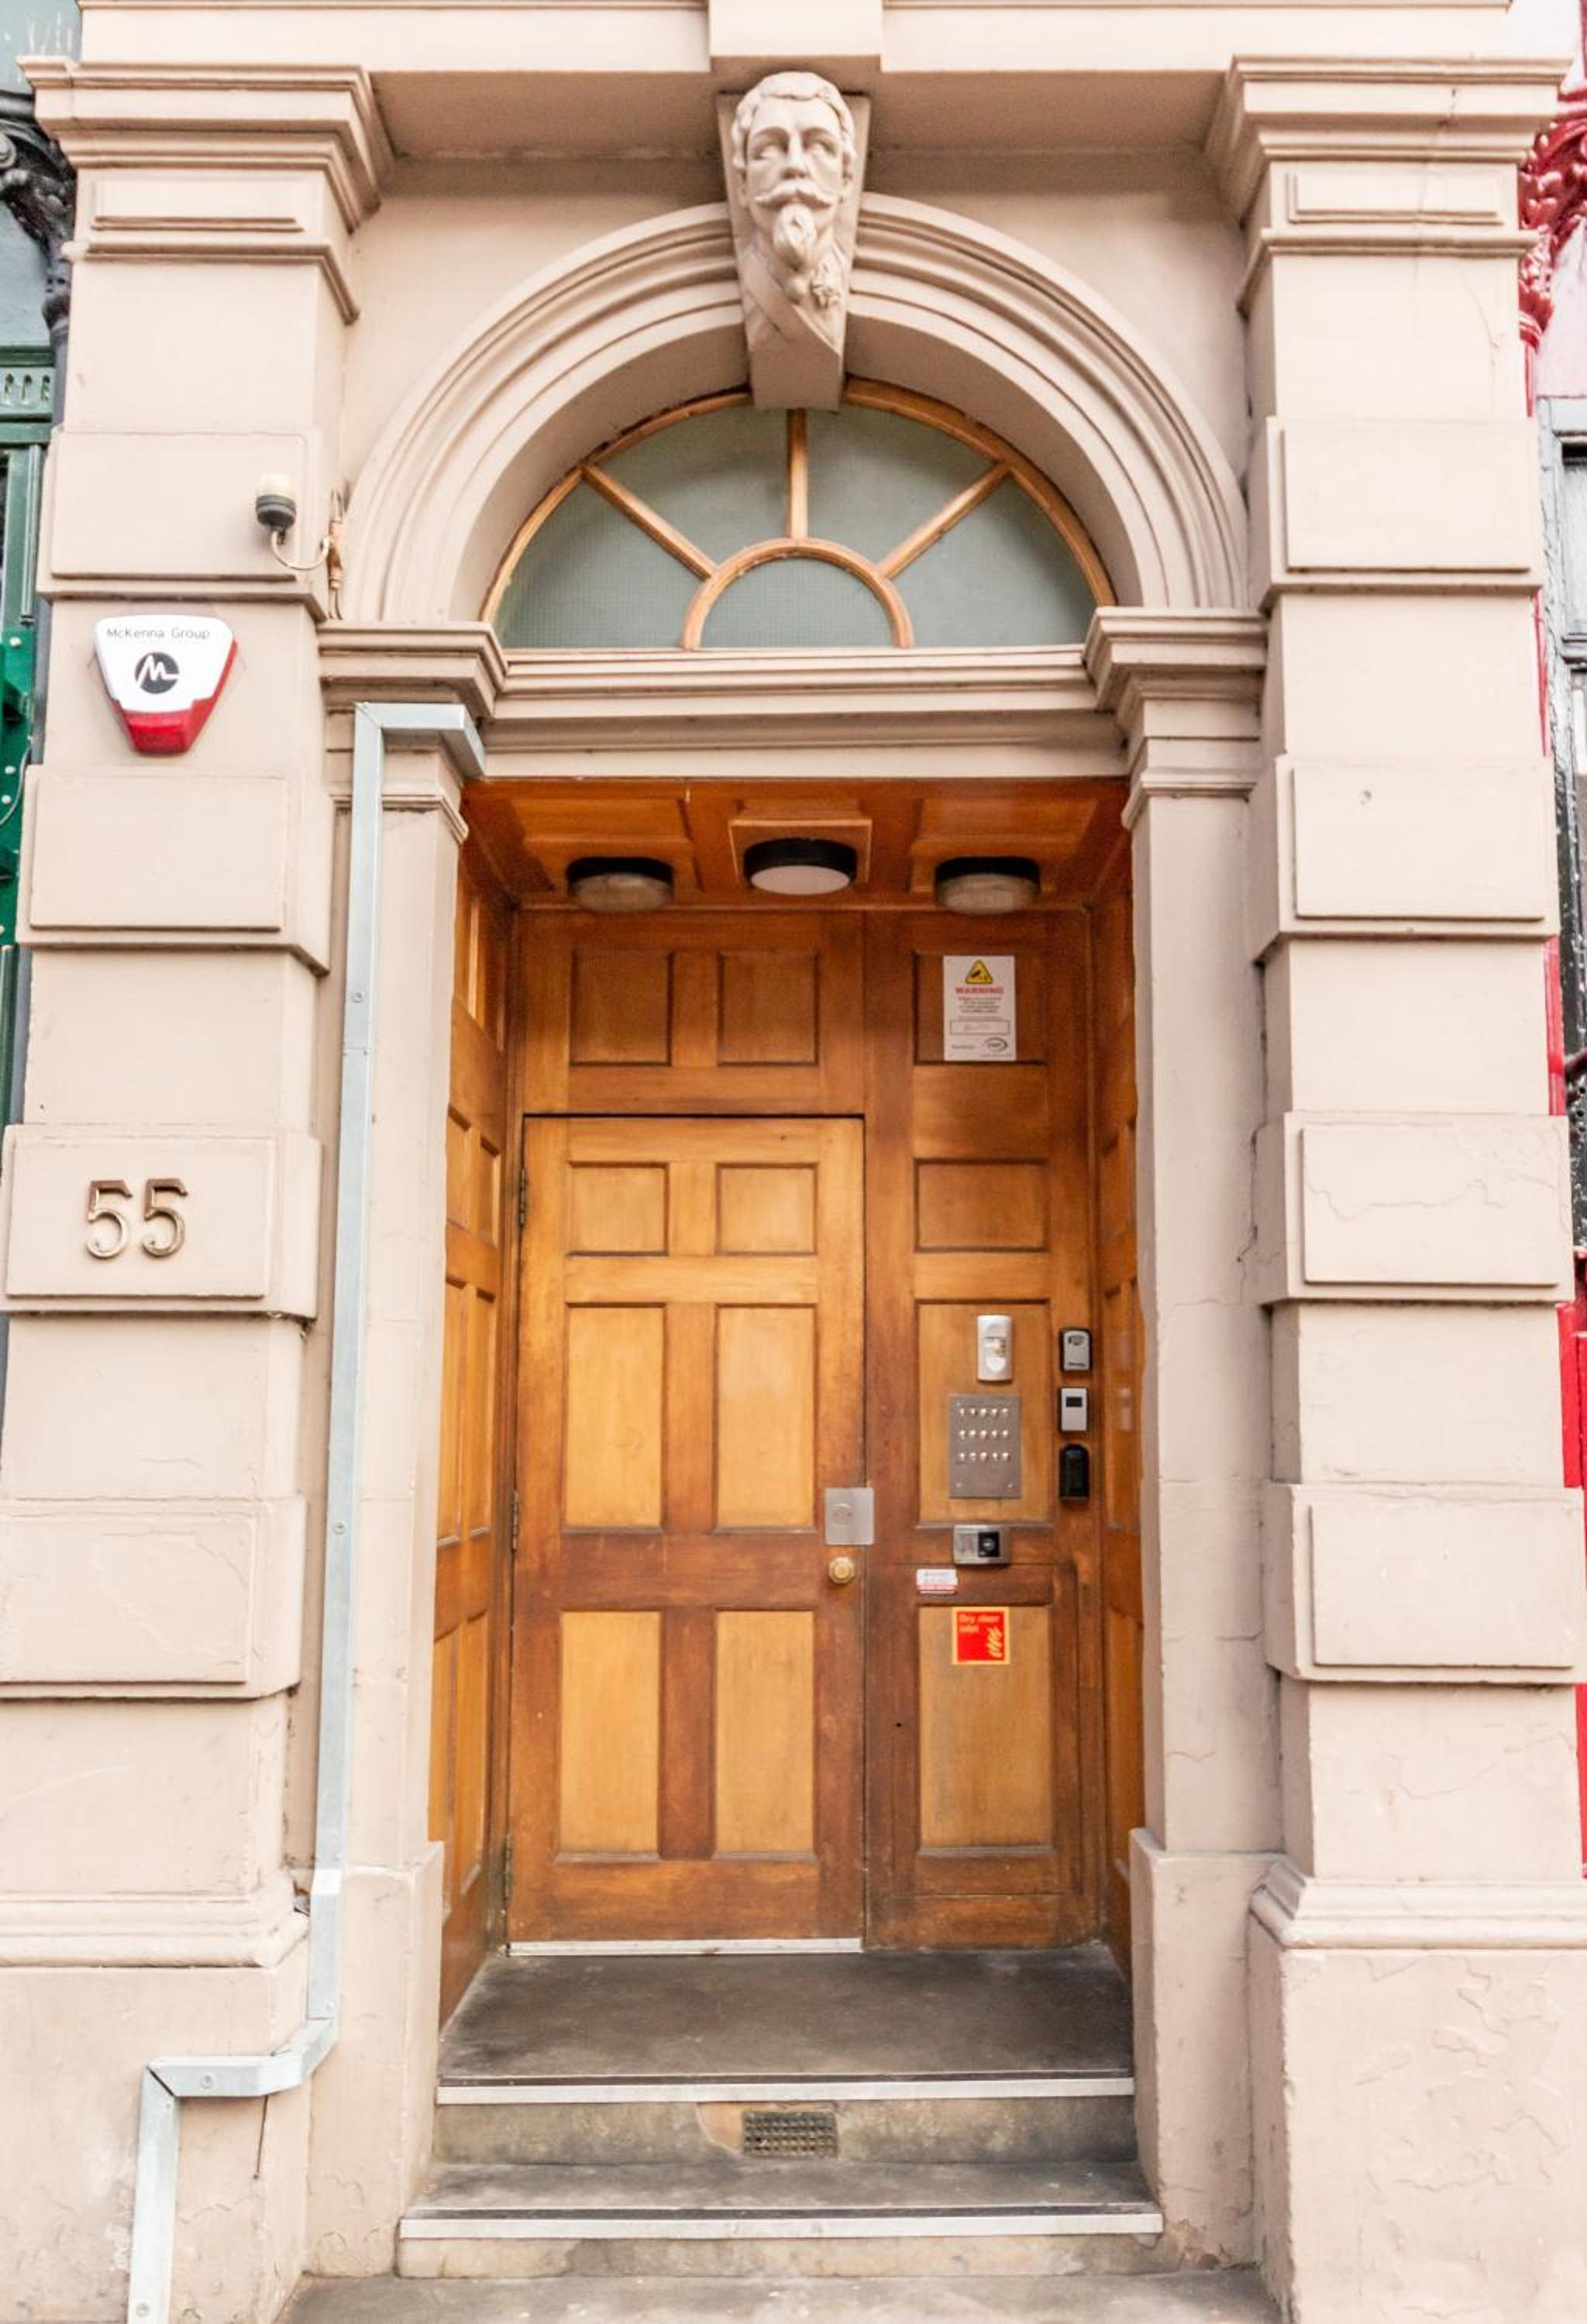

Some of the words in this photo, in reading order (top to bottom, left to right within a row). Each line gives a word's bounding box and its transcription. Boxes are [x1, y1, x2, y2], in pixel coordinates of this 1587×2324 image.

[107, 627, 164, 639] McKenna
[171, 627, 210, 640] Group
[87, 1179, 188, 1260] 55
